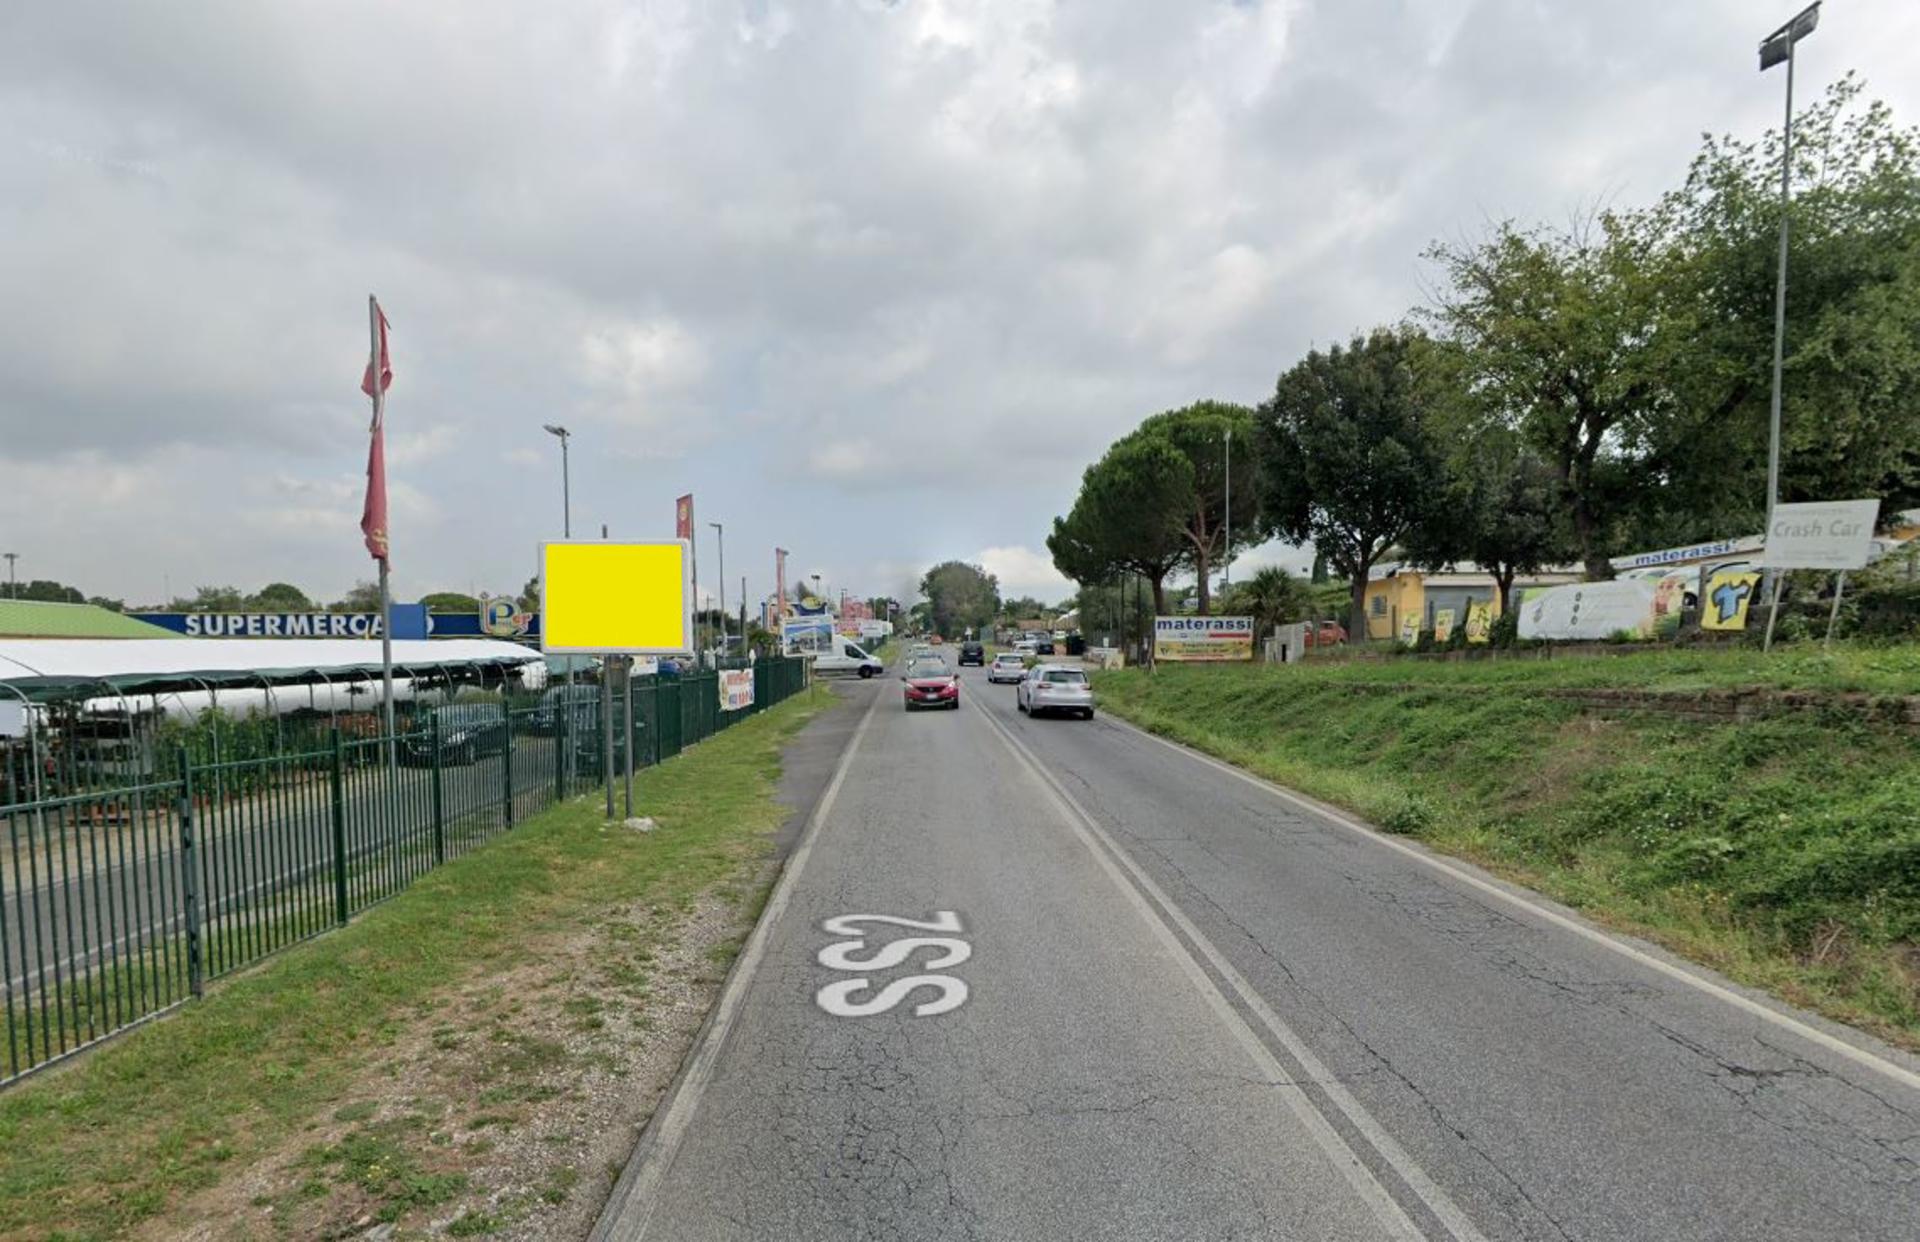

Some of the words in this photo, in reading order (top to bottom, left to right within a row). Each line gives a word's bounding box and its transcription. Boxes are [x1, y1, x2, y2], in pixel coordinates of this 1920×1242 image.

[1774, 518, 1822, 537] Crash
[1830, 518, 1862, 536] Car
[1635, 542, 1731, 565] materassi
[1157, 617, 1252, 630] materassi
